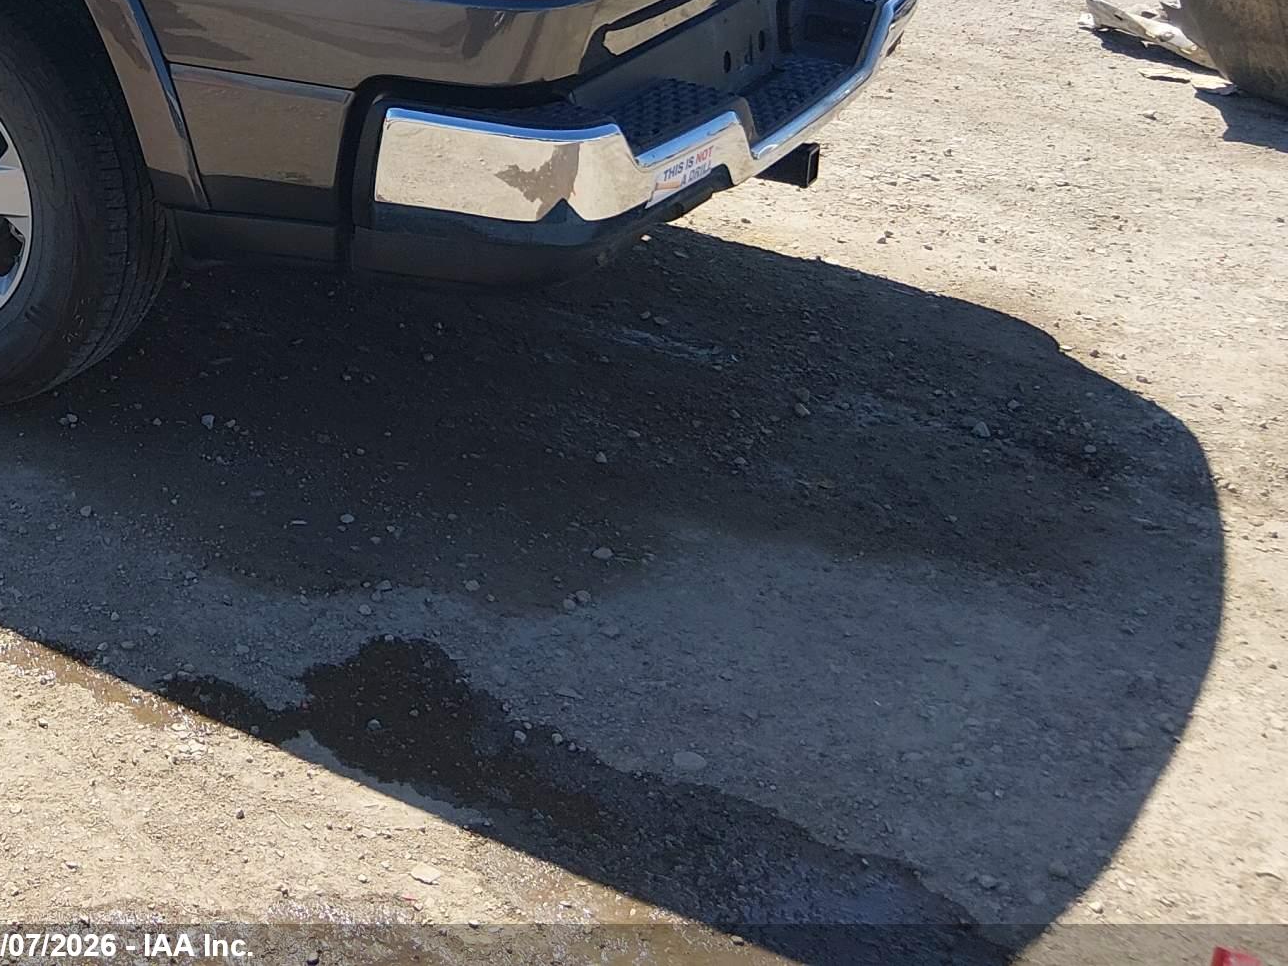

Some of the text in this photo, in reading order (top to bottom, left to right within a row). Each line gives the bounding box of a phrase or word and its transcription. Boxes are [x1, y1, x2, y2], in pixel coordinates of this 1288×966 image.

[663, 145, 714, 182] THIS IS NOT
